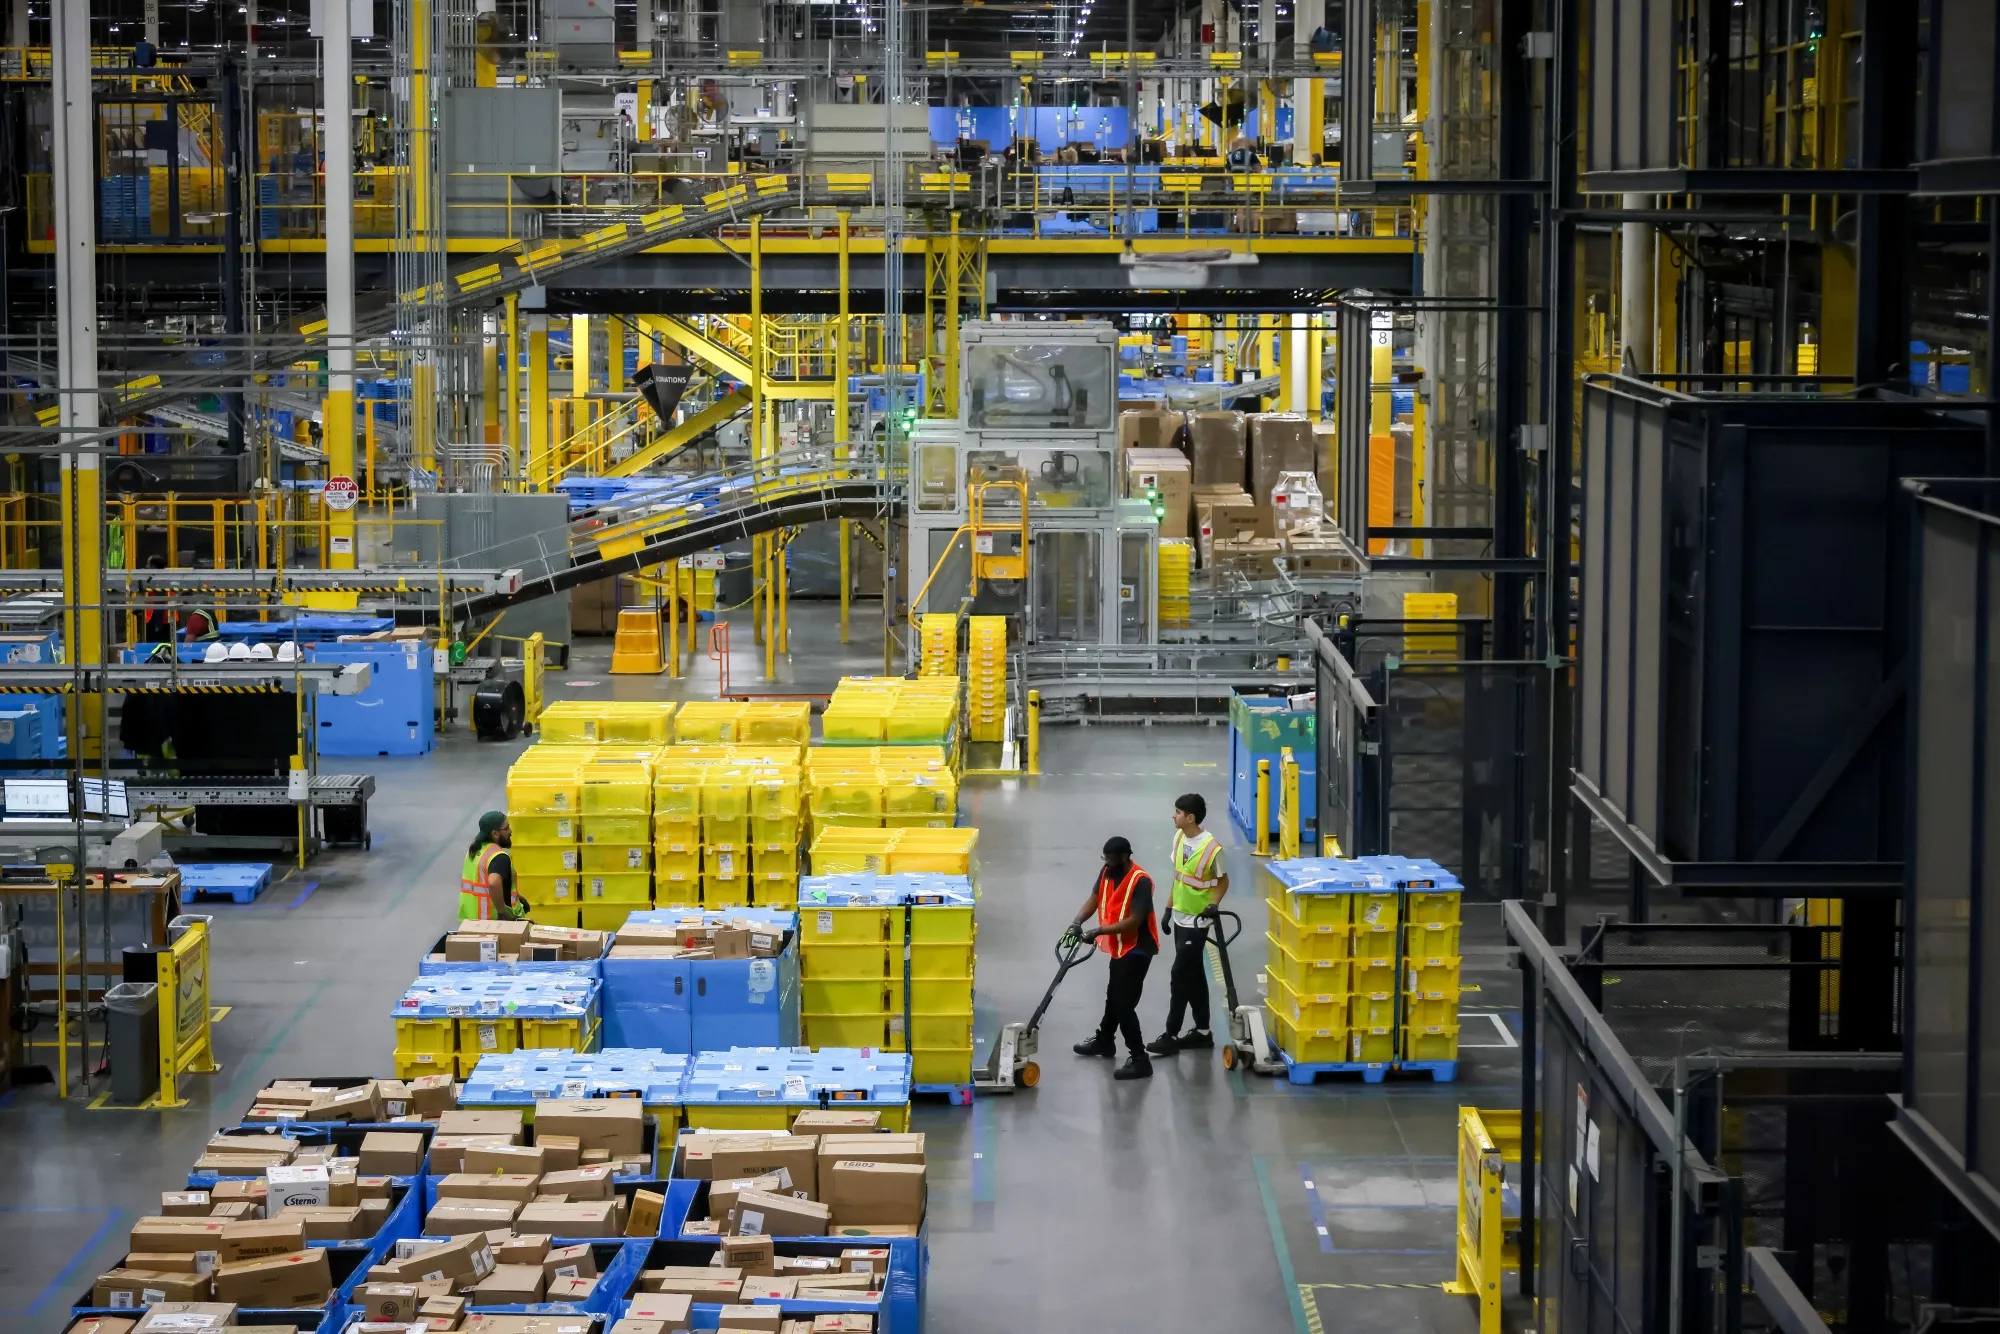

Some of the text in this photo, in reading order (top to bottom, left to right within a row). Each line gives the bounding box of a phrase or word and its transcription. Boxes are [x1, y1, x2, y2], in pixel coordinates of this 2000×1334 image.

[1379, 332, 1388, 344] 8
[329, 481, 353, 490] STOP
[290, 1197, 317, 1206] Sterno
